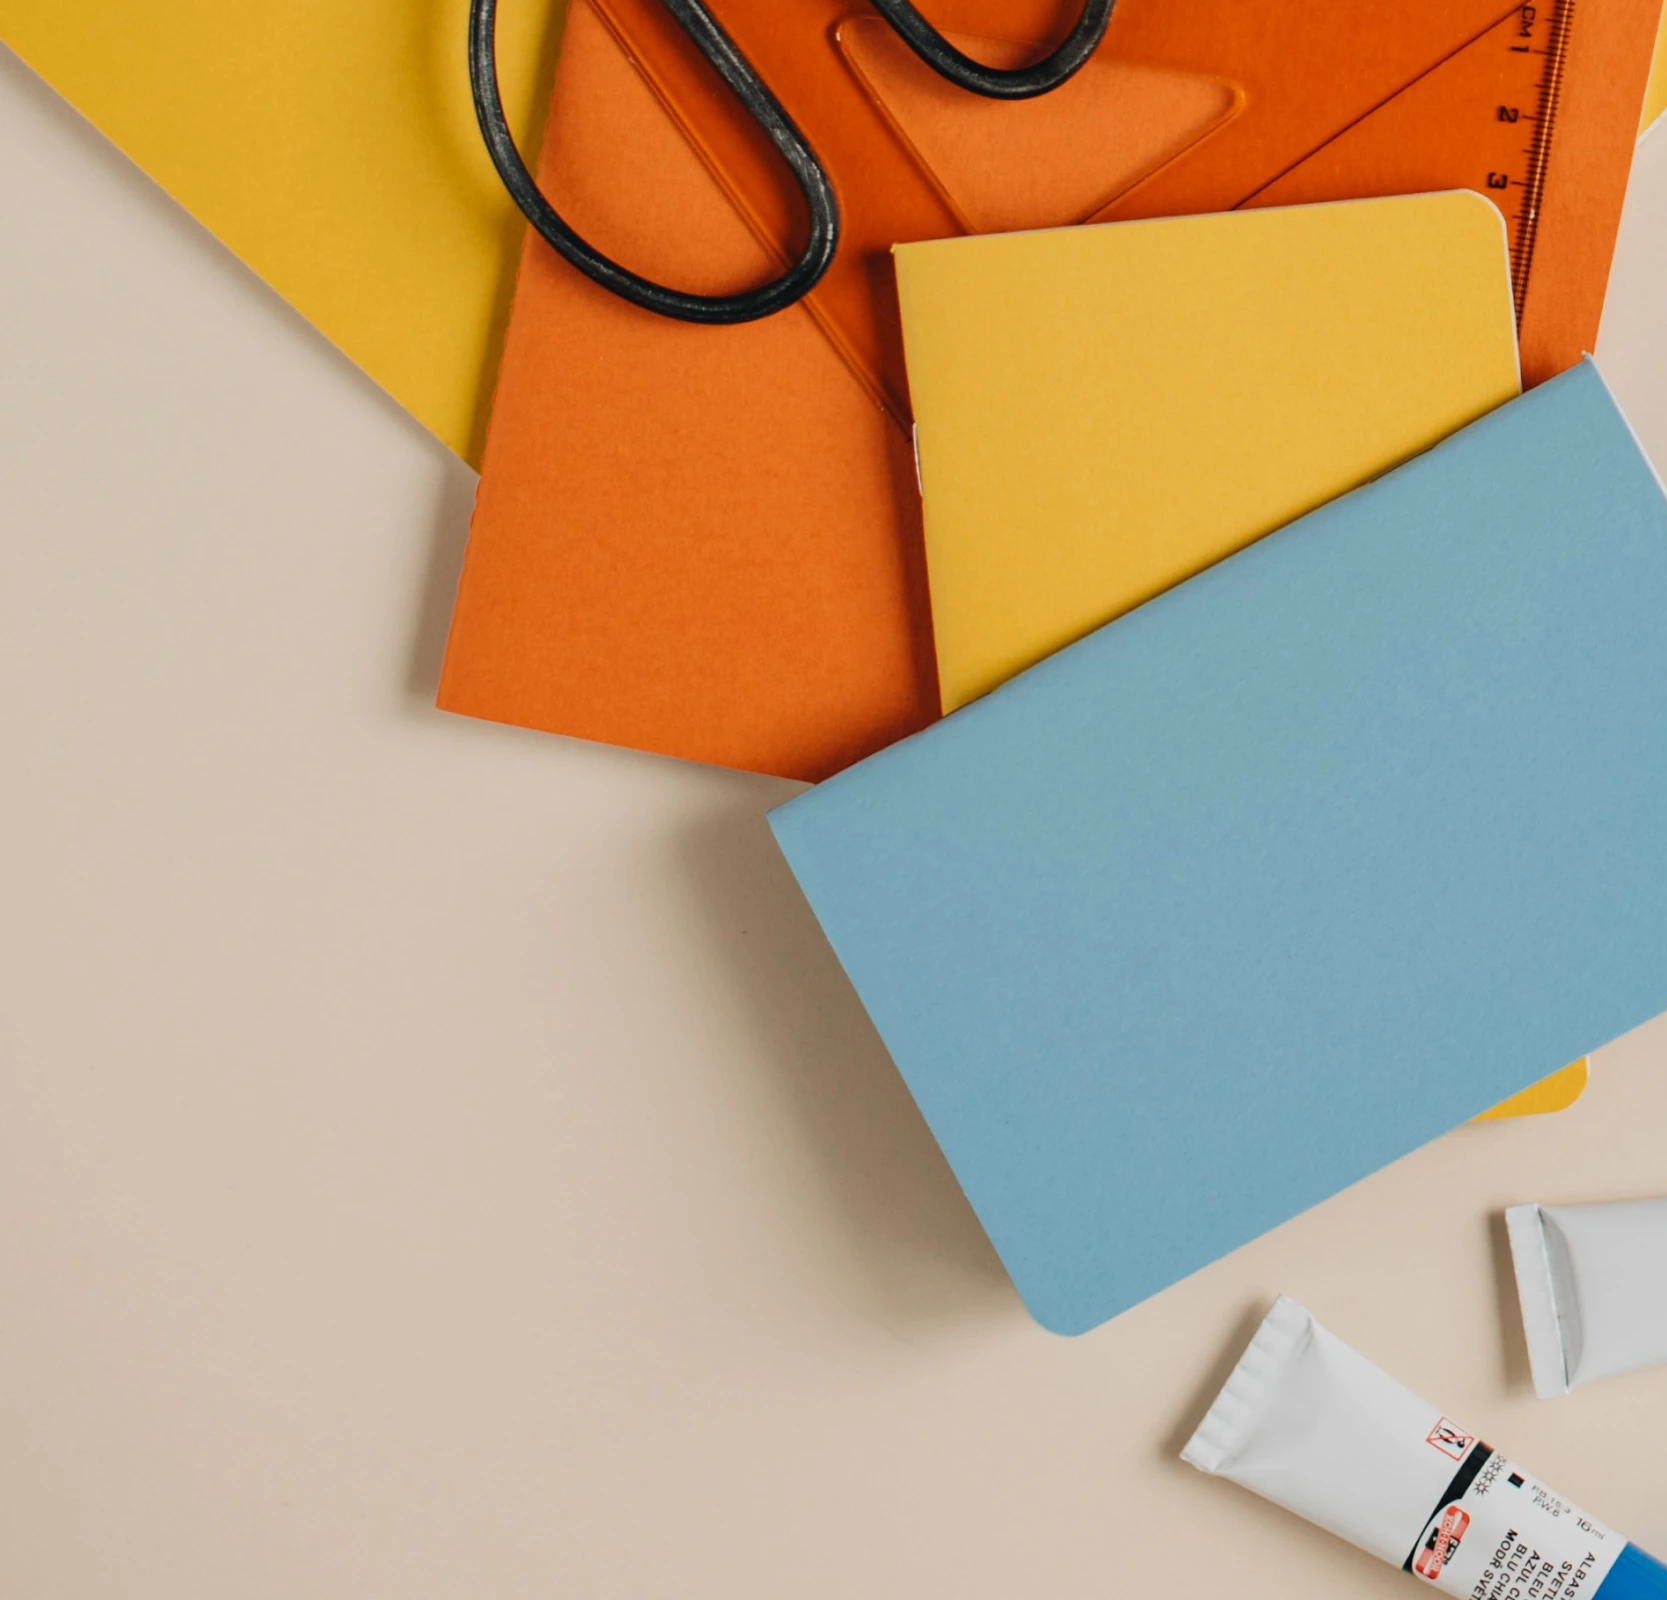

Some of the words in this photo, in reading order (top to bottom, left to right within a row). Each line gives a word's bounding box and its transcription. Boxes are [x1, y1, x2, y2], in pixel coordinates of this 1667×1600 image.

[1518, 5, 1536, 38] CM
[1510, 45, 1529, 53] 1
[1498, 105, 1519, 124] 2
[1487, 171, 1508, 190] 3
[1431, 1514, 1455, 1572] KOH-I-NOOR
[1506, 1543, 1528, 1572] BLU
[1514, 1549, 1541, 1584] AZUL
[1527, 1561, 1554, 1599] BLEU
[1468, 1569, 1495, 1600] SVĚT
